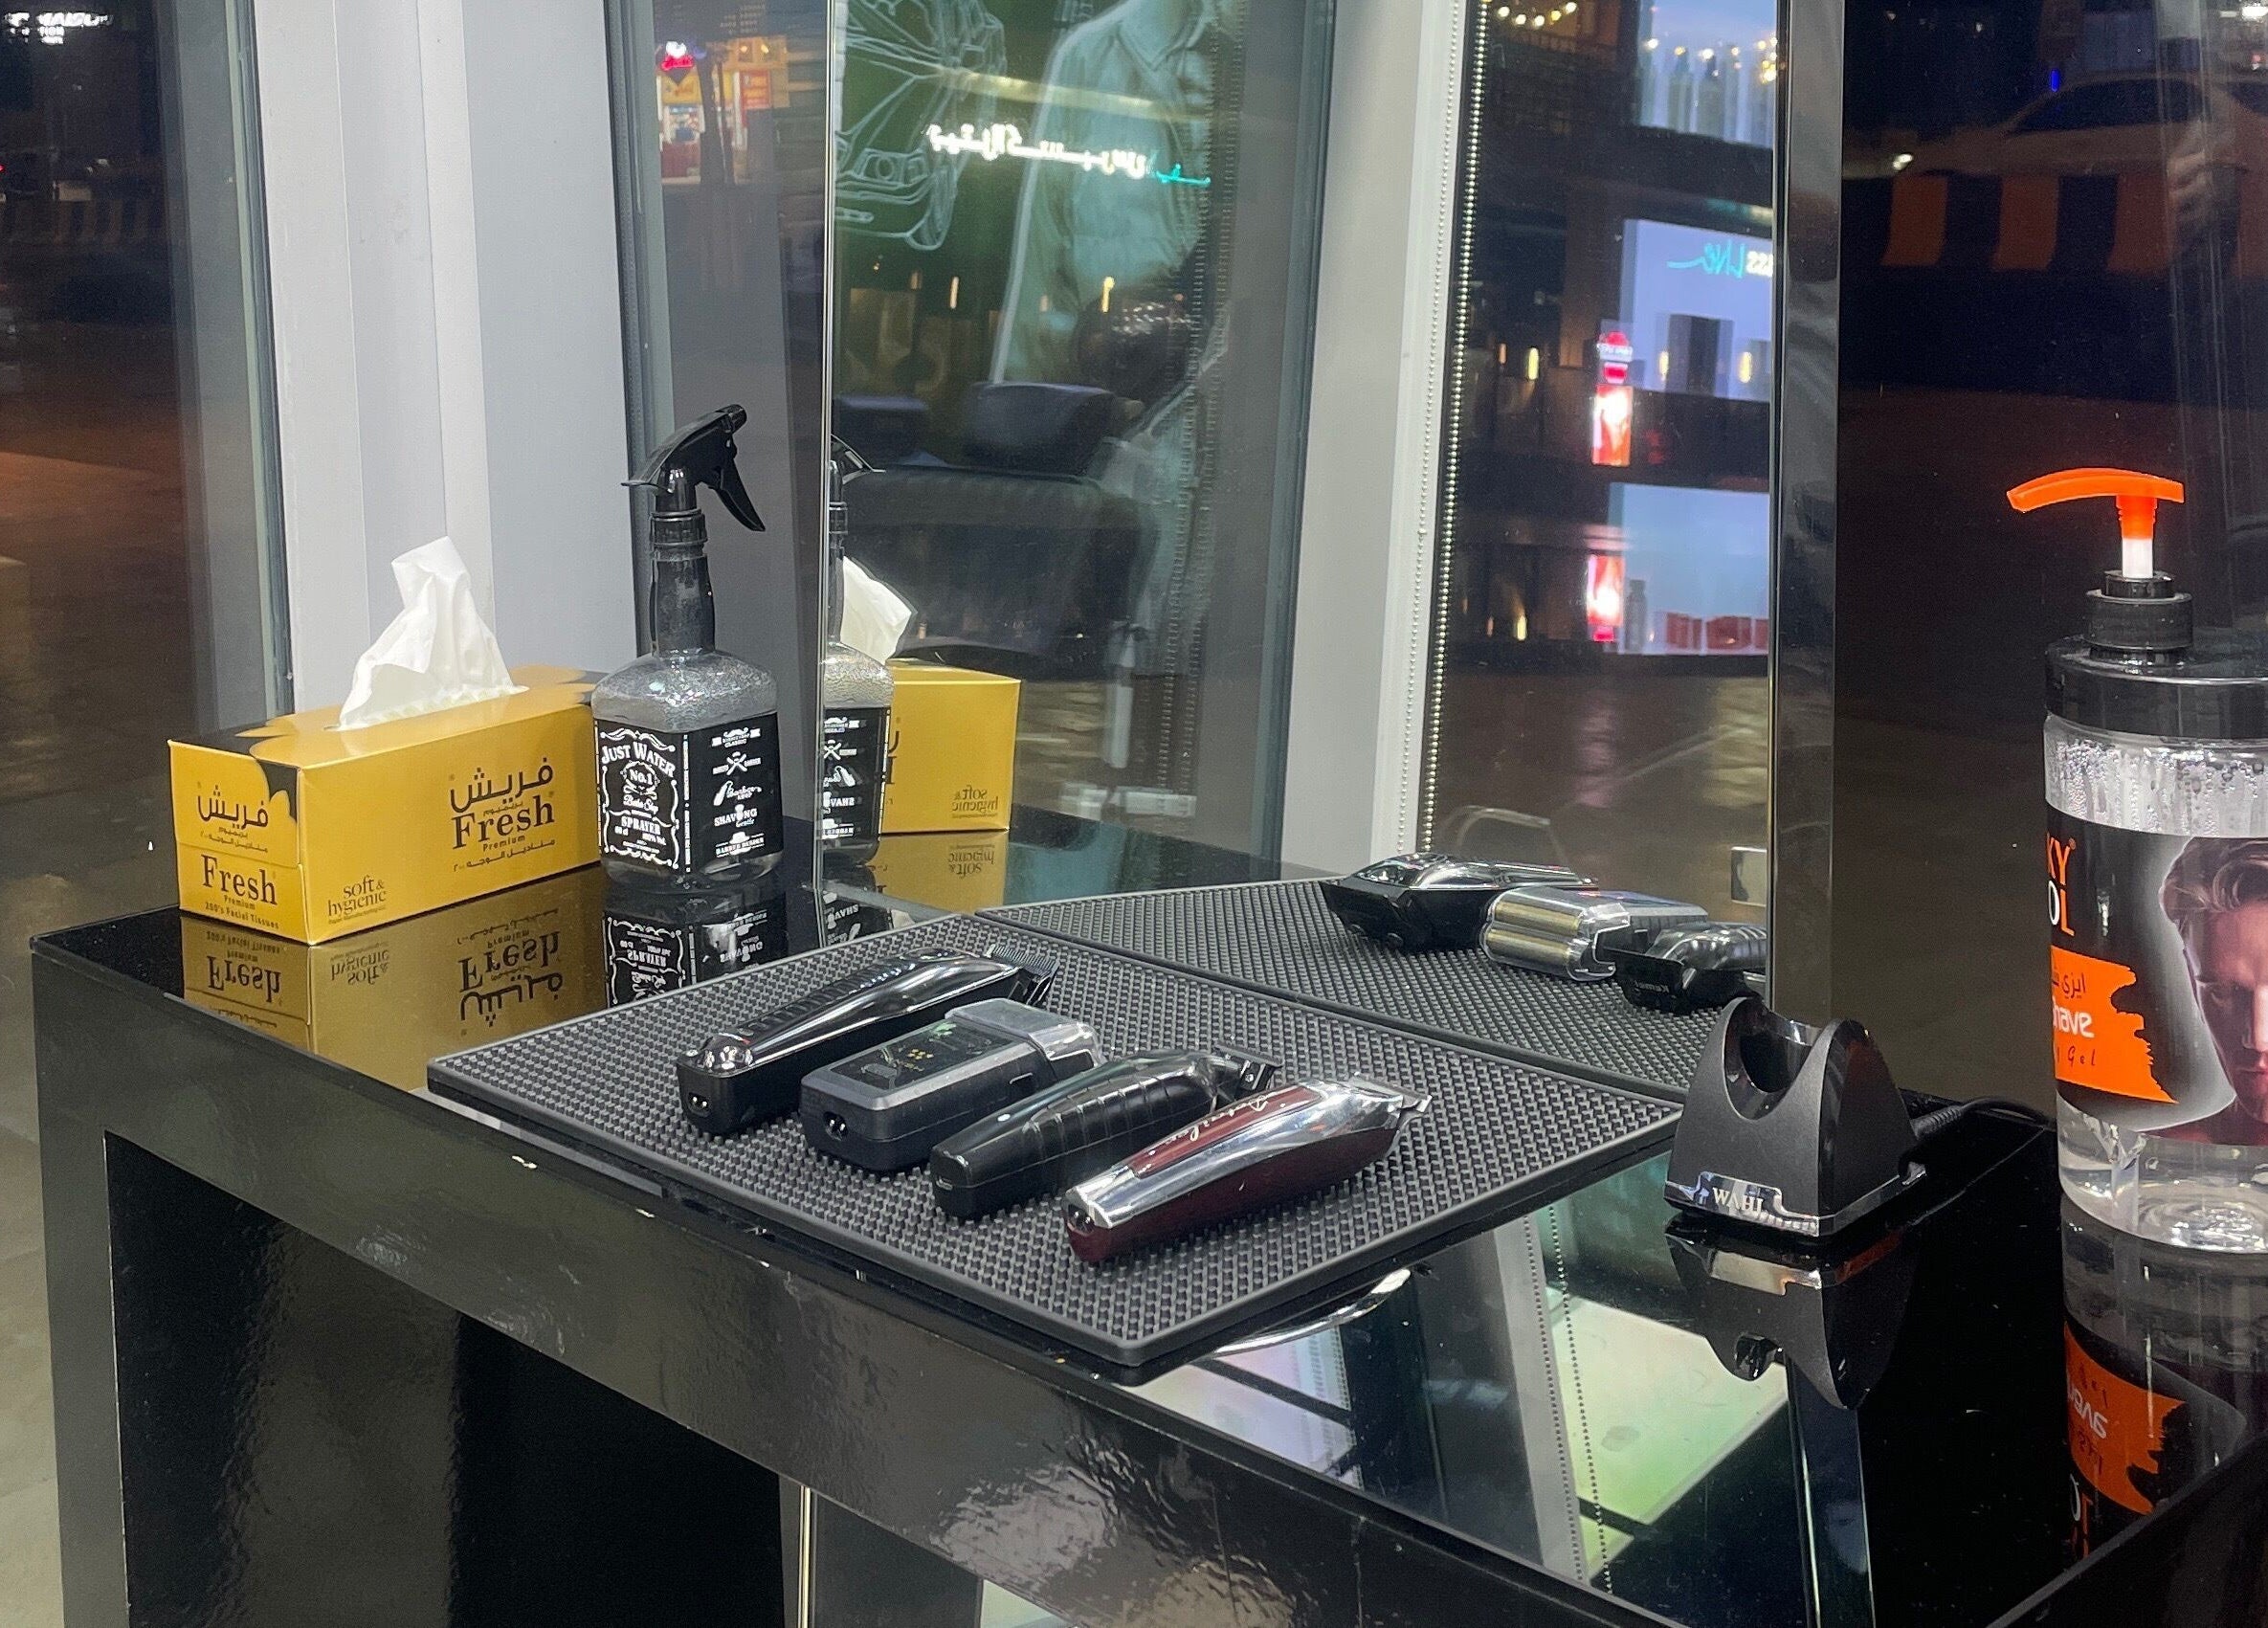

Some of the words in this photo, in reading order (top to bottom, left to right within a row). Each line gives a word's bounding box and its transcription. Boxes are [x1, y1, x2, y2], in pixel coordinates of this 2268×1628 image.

[601, 745, 631, 764] JUST
[633, 741, 676, 777] WATER
[450, 757, 553, 813] فريش
[197, 785, 268, 830] فريش
[451, 794, 555, 850] Fresh
[482, 835, 525, 852] Premium
[2046, 832, 2071, 886] KY
[201, 854, 278, 905] Fresh
[344, 874, 374, 899] soft
[327, 890, 387, 916] hygienic
[2048, 880, 2075, 937] OL
[2052, 994, 2095, 1038] have
[2067, 1045, 2096, 1068] Gel
